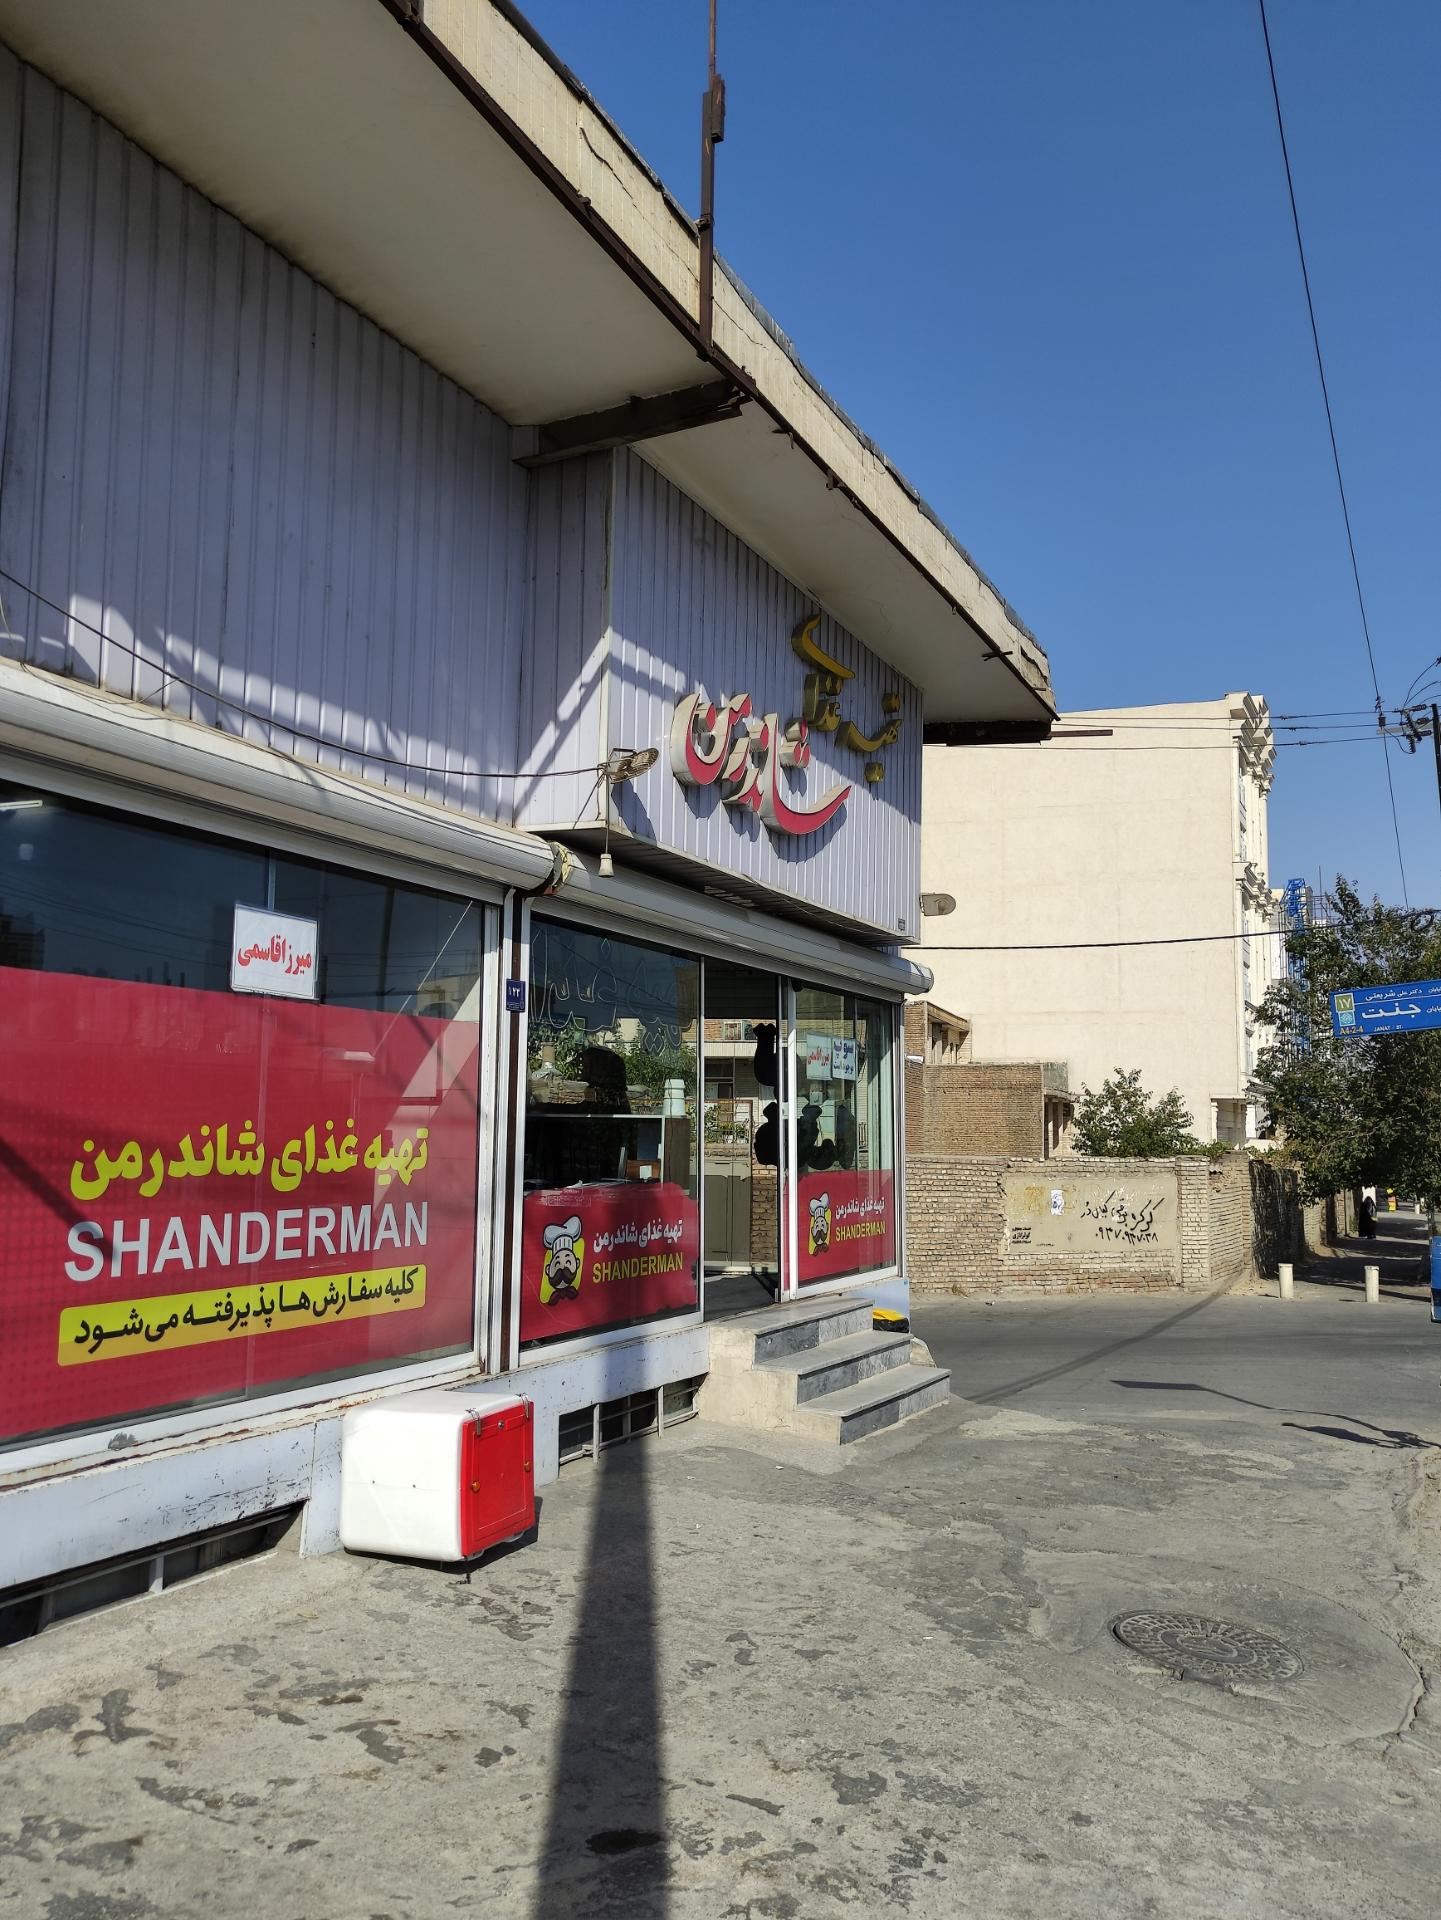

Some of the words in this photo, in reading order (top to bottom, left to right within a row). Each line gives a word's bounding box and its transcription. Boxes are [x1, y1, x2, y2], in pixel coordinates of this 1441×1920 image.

[1338, 998, 1351, 1009] ۱۷
[1361, 1002, 1422, 1019] جنت
[1365, 989, 1396, 1001] شریعتی
[70, 1119, 265, 1201] شاندرمن
[270, 1118, 359, 1192] غذای
[364, 1127, 429, 1186] تهیه
[835, 1197, 860, 1220] شاندرمن
[859, 1195, 873, 1217] غذای
[873, 1196, 885, 1214] تهیه
[64, 1201, 428, 1282] SHANDERMAN
[593, 1221, 638, 1253] شاندرمن
[638, 1217, 662, 1248] غذای
[663, 1219, 683, 1244] تهیه
[835, 1220, 886, 1242] SHANDERMAN
[592, 1251, 683, 1284] SHANDERMAN
[385, 1267, 418, 1303] کلیه
[183, 1286, 275, 1332] پذیرفته
